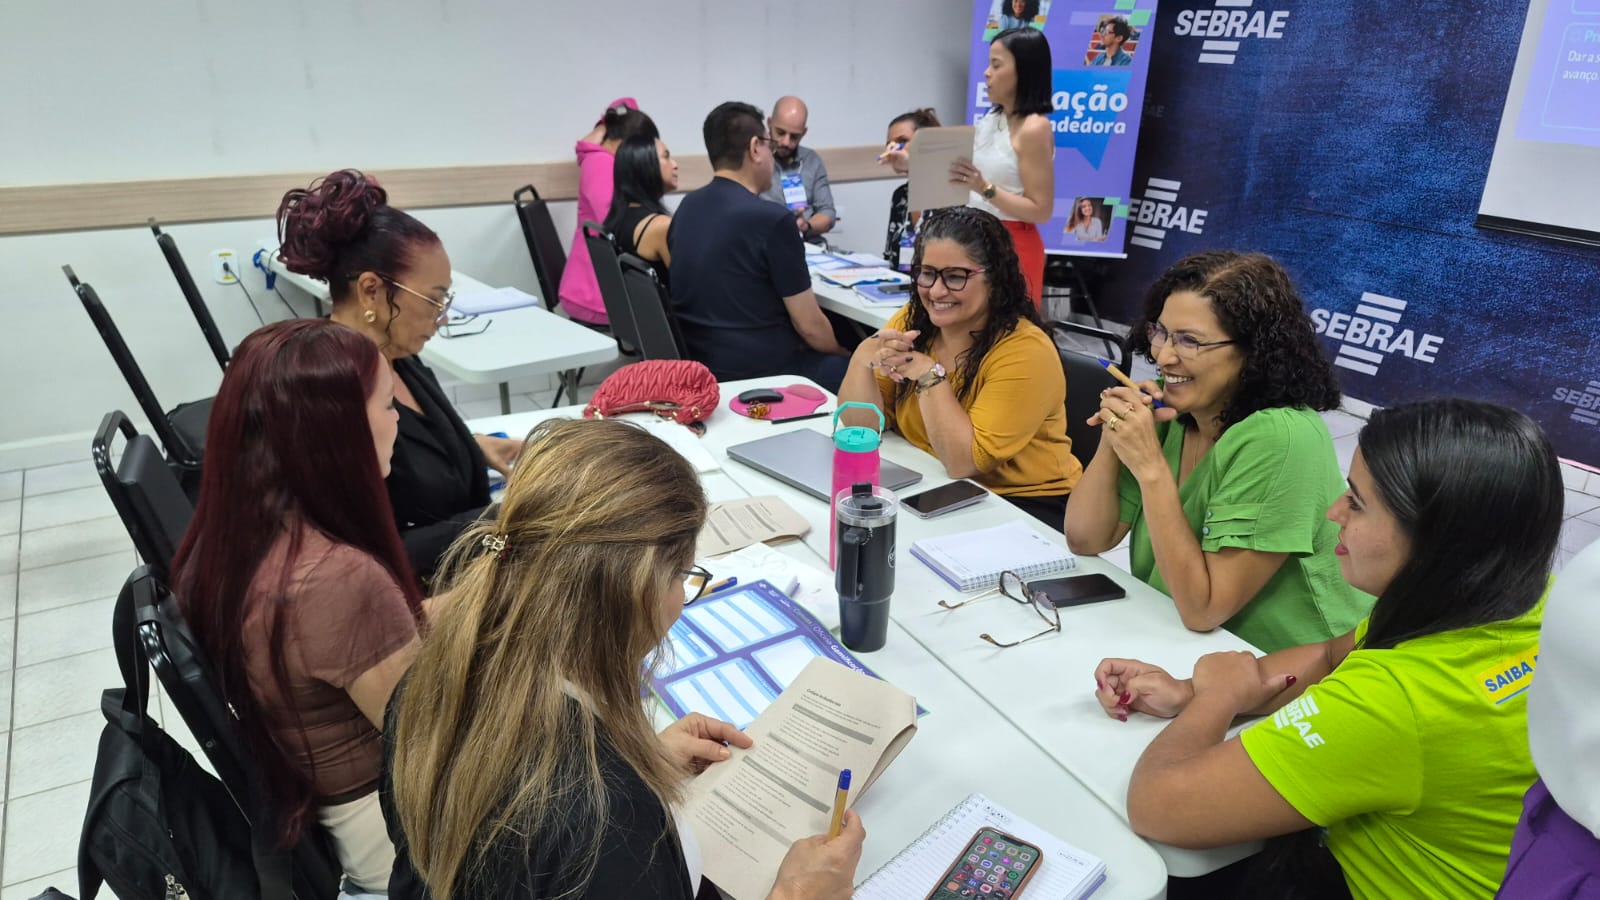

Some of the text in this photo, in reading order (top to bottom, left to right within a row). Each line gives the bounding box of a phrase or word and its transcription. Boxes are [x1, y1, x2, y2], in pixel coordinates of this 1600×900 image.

[1174, 10, 1289, 39] SEBRAE
[1128, 198, 1208, 235] EBRAE
[1309, 308, 1444, 364] SEBRAE
[1485, 661, 1534, 692] SAIBA
[1286, 699, 1326, 749] BRAE
